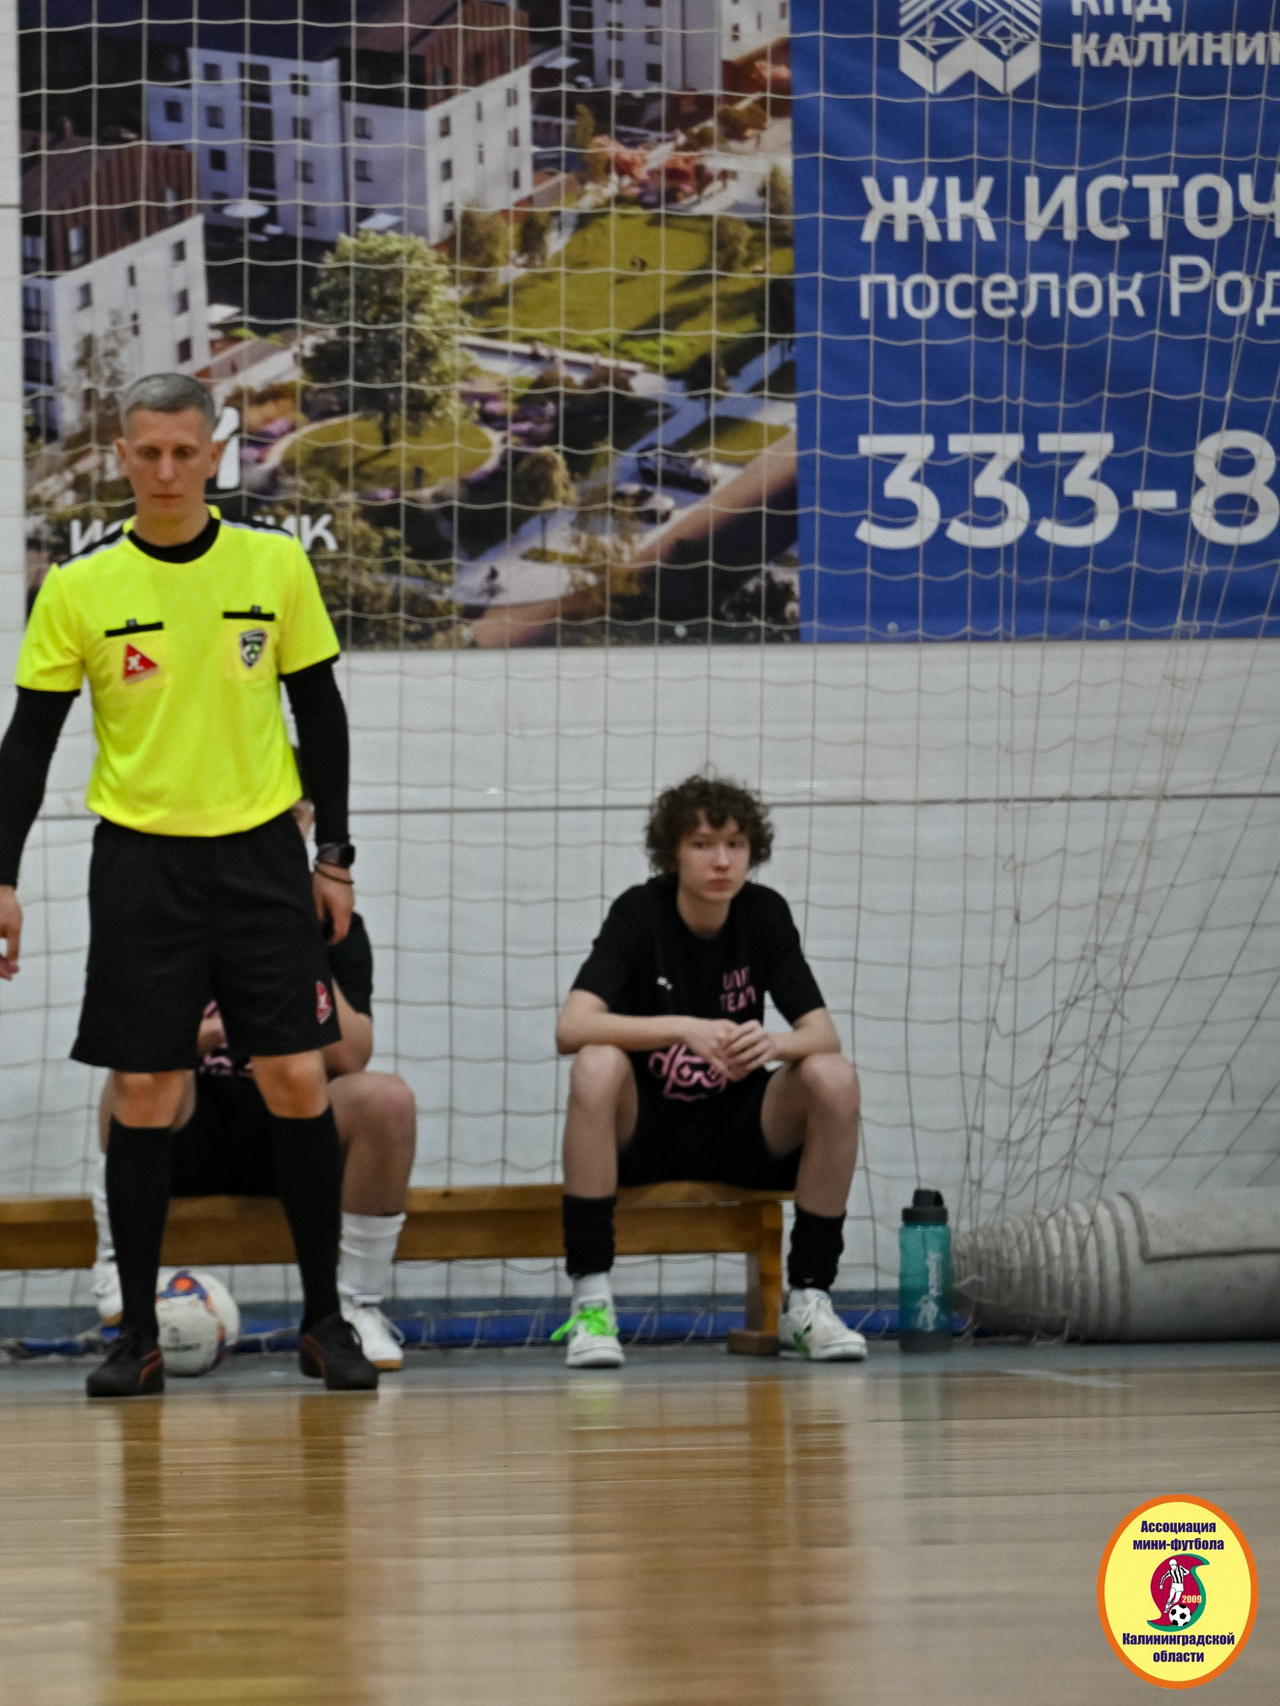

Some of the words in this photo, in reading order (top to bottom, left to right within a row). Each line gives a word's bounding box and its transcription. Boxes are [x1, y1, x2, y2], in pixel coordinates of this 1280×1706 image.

[860, 176, 996, 242] ЖК
[1024, 173, 1280, 241] ИСТОЧ
[859, 271, 1145, 320] поселок
[854, 429, 1280, 550] 333-8
